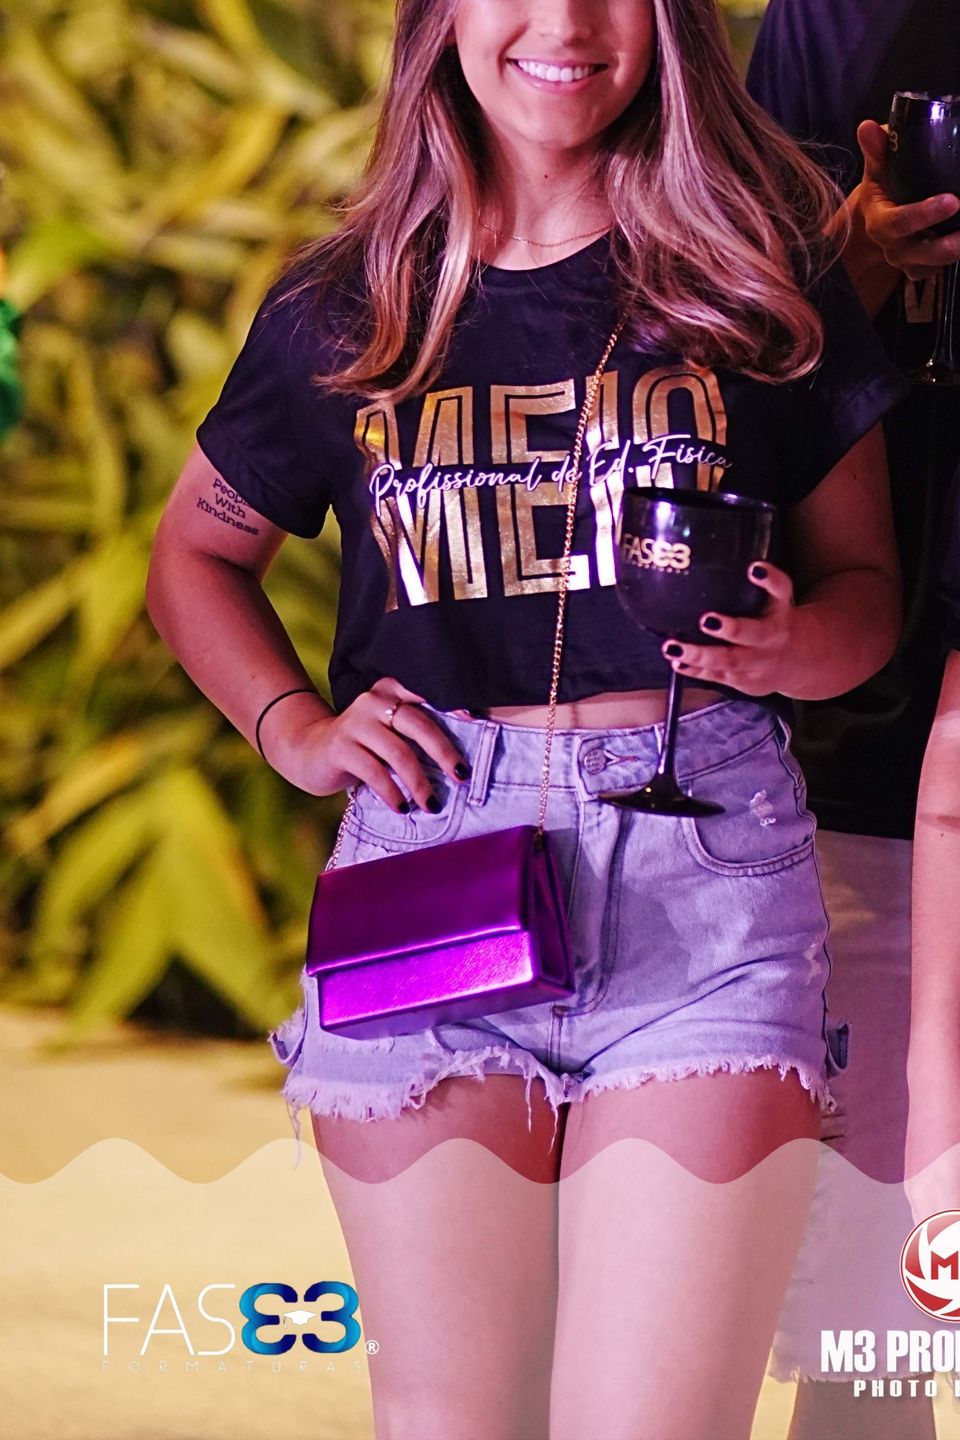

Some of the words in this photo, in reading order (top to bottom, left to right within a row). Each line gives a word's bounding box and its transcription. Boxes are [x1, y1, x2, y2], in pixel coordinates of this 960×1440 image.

[213, 478, 248, 506] Peop
[369, 463, 542, 517] Profissional
[551, 455, 582, 492] de
[587, 439, 634, 487] Ed.
[197, 498, 259, 535] Kindness
[215, 493, 246, 519] With
